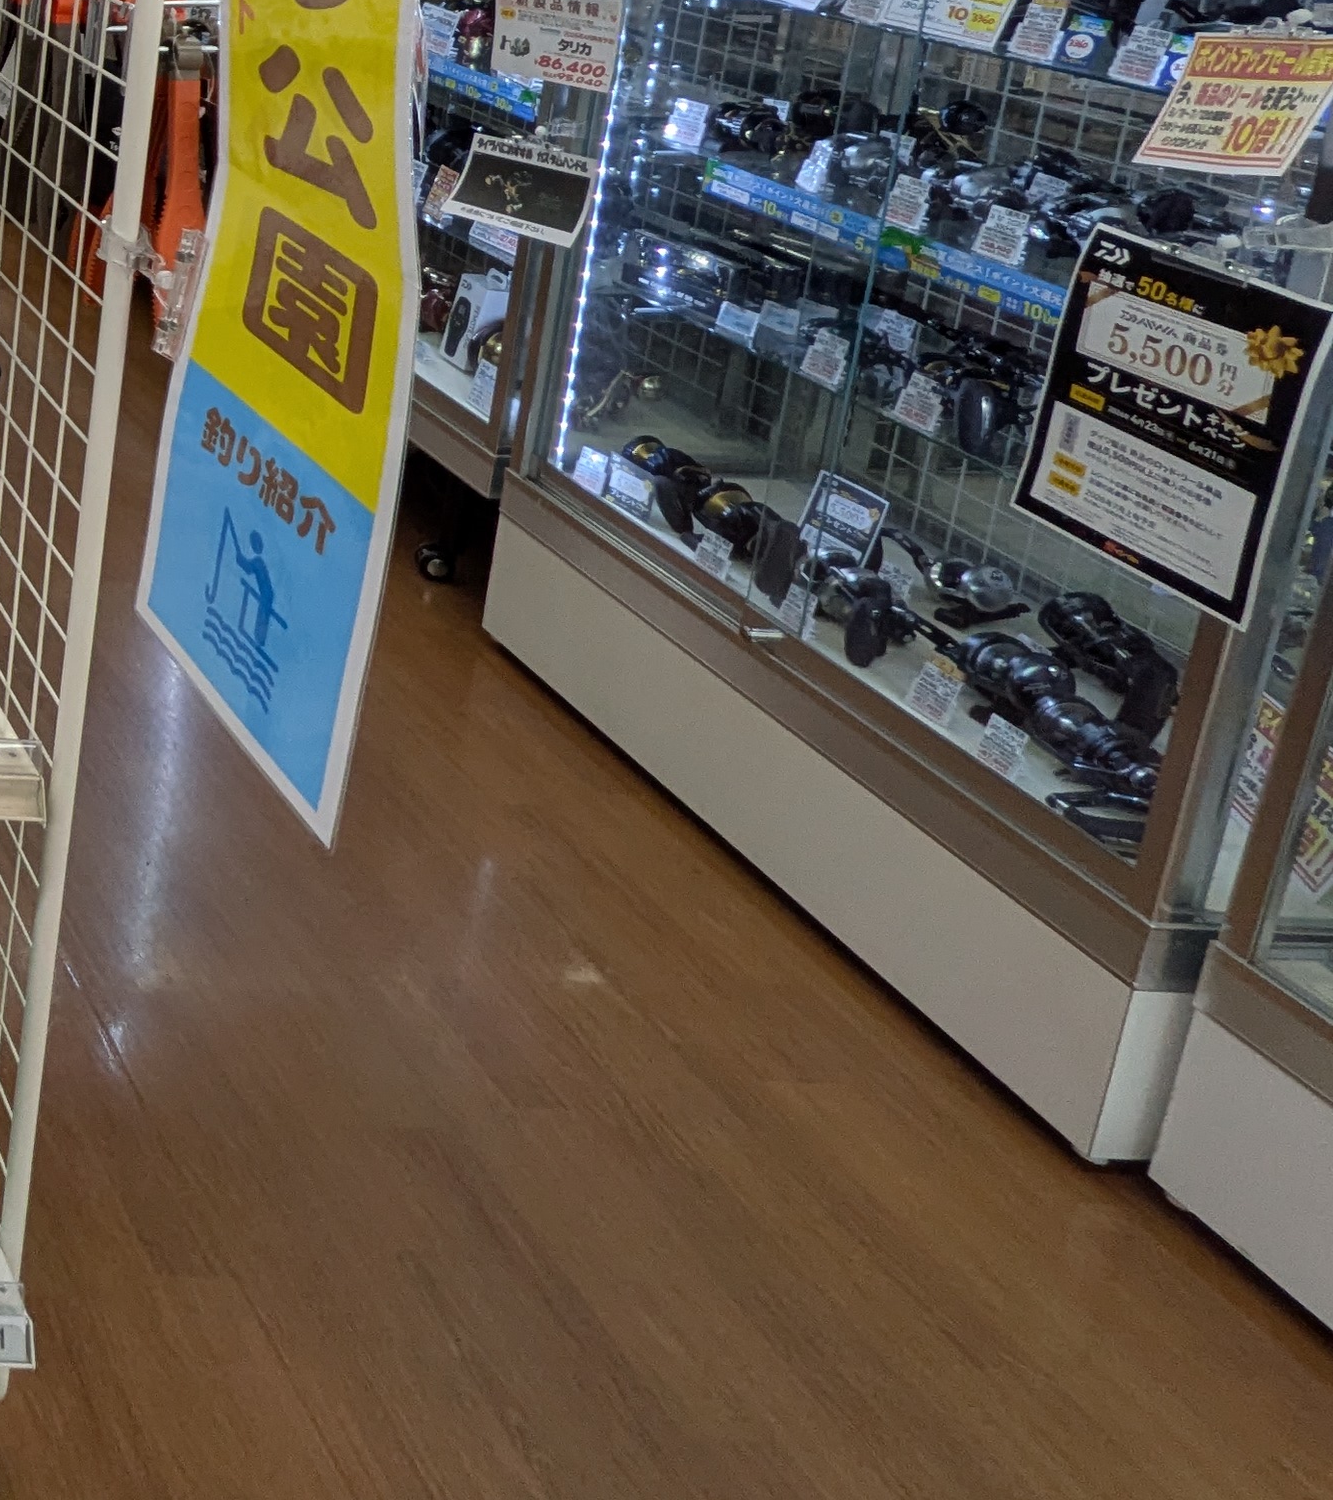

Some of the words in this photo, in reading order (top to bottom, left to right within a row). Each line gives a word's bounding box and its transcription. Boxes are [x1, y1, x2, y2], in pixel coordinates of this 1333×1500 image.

[1109, 322, 1215, 387] 5,500
[1087, 362, 1202, 427] プレゼント
[200, 405, 338, 555] 釣り紹介
